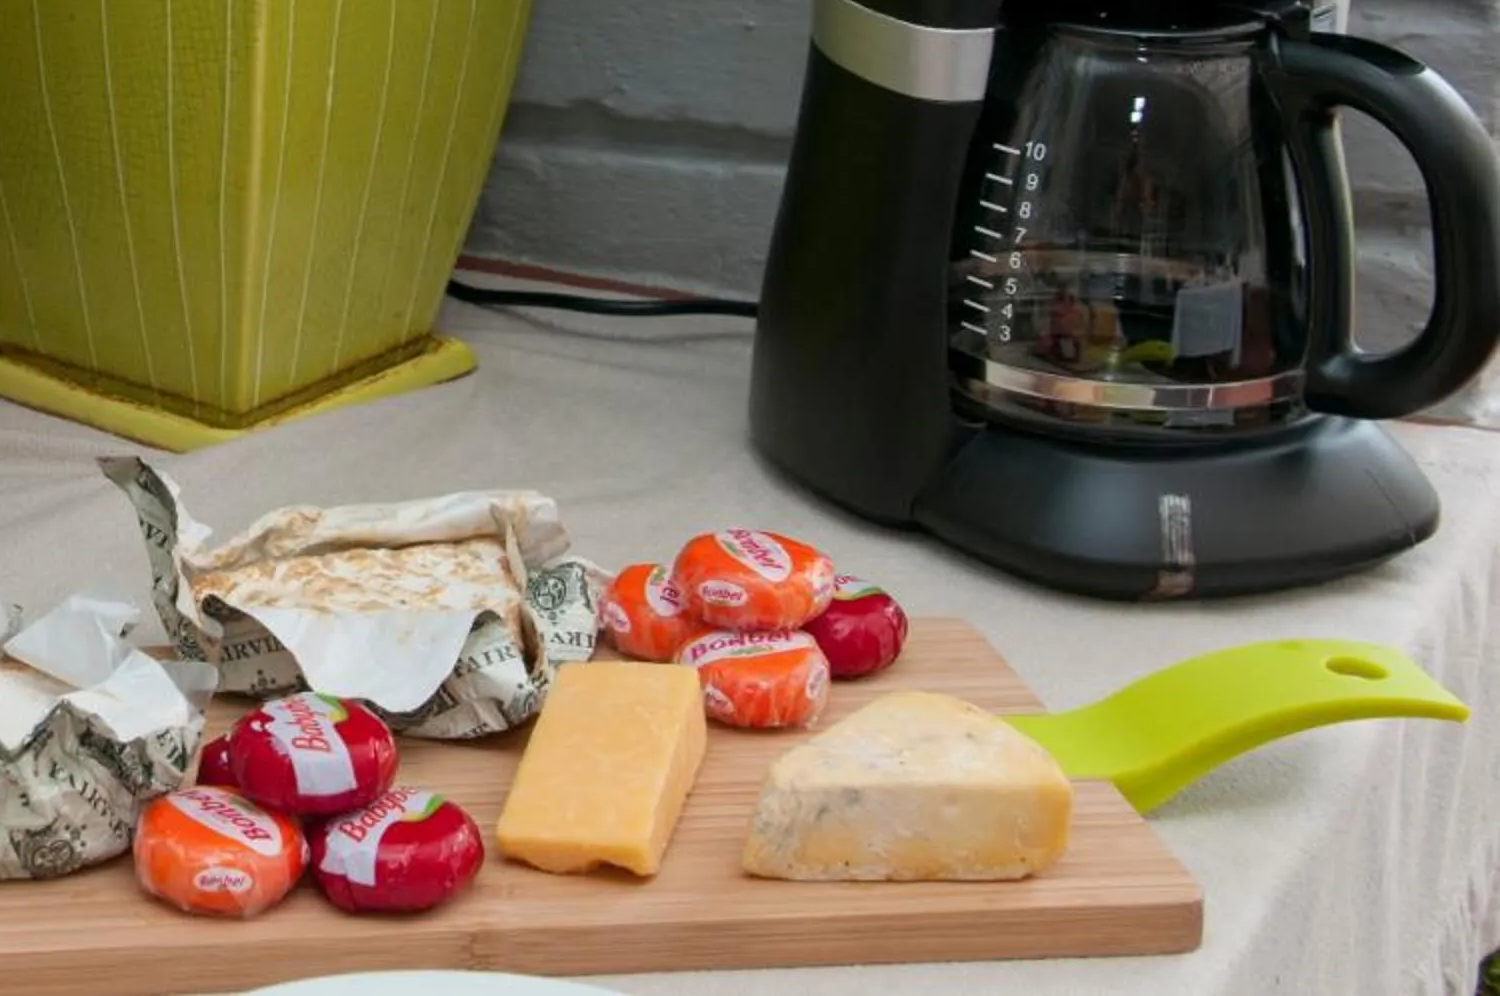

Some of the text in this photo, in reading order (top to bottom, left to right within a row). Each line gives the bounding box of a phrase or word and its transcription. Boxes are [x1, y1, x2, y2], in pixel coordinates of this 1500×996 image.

[1025, 141, 1047, 161] 10
[1025, 173, 1039, 191] 9
[1019, 201, 1032, 219] 8
[1014, 227, 1028, 244] 7
[1009, 251, 1021, 269] 6
[1005, 277, 1017, 295] 5
[1001, 303, 1013, 319] 4
[999, 325, 1011, 342] 3
